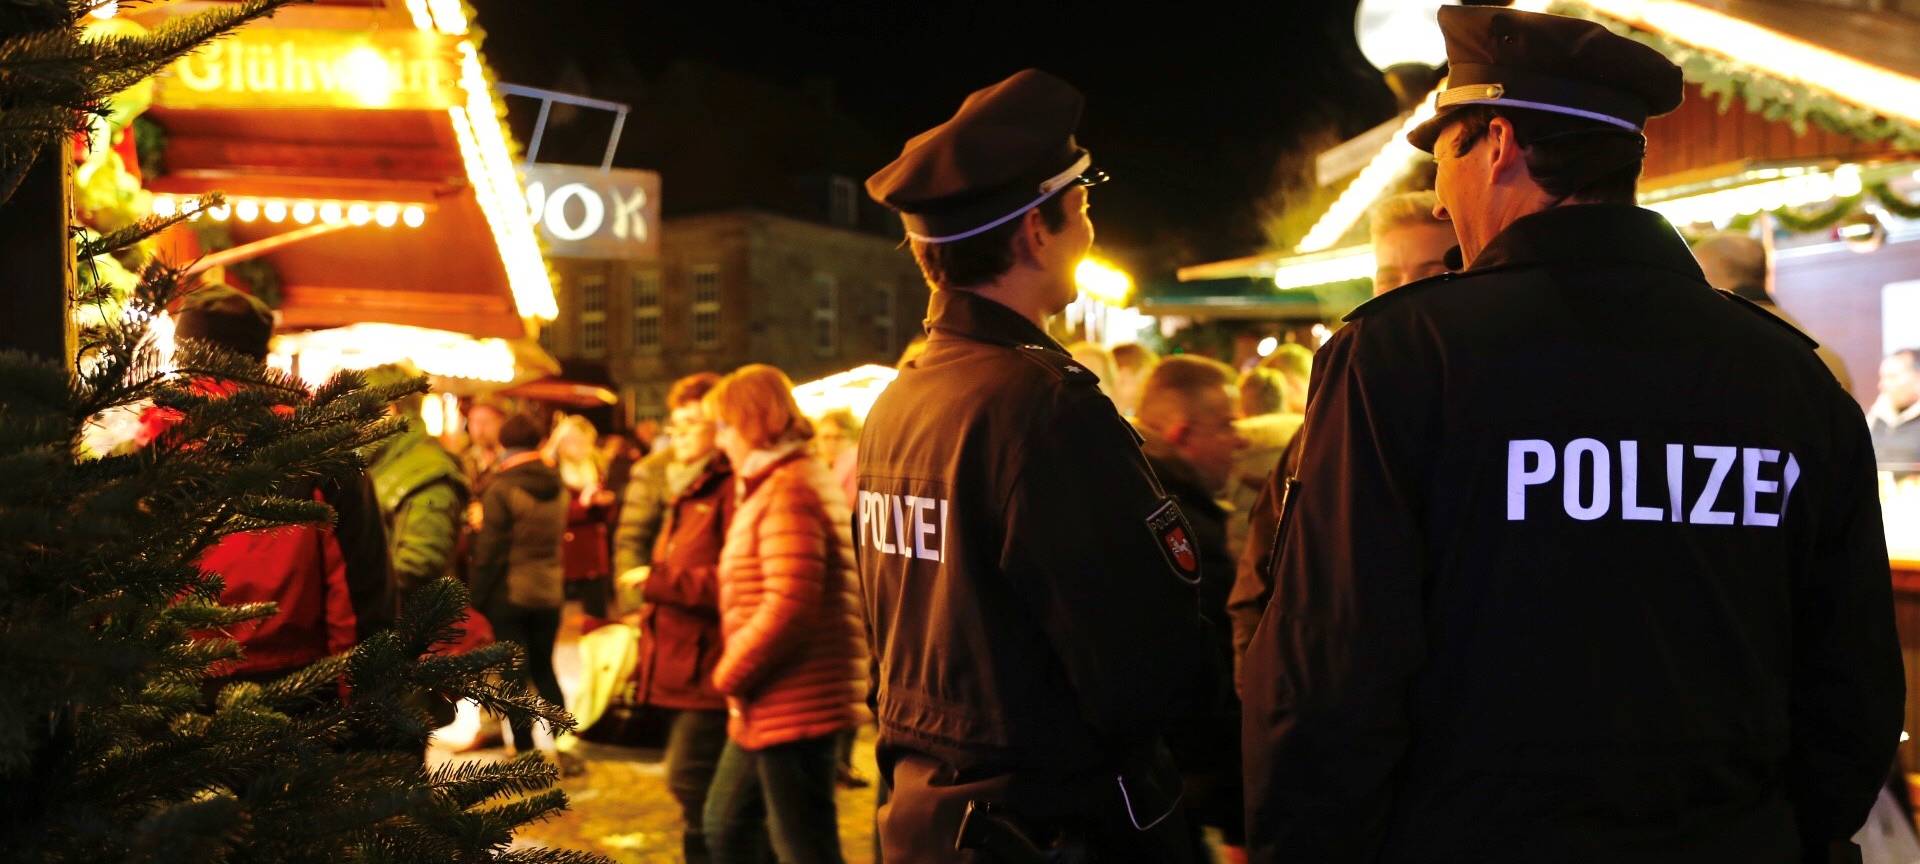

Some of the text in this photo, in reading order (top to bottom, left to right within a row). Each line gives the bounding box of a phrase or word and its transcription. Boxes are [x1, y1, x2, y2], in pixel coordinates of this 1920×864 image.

[178, 41, 438, 92] Glühwin
[1507, 437, 1800, 527] POLIZEI
[858, 490, 948, 564] POLIZEI
